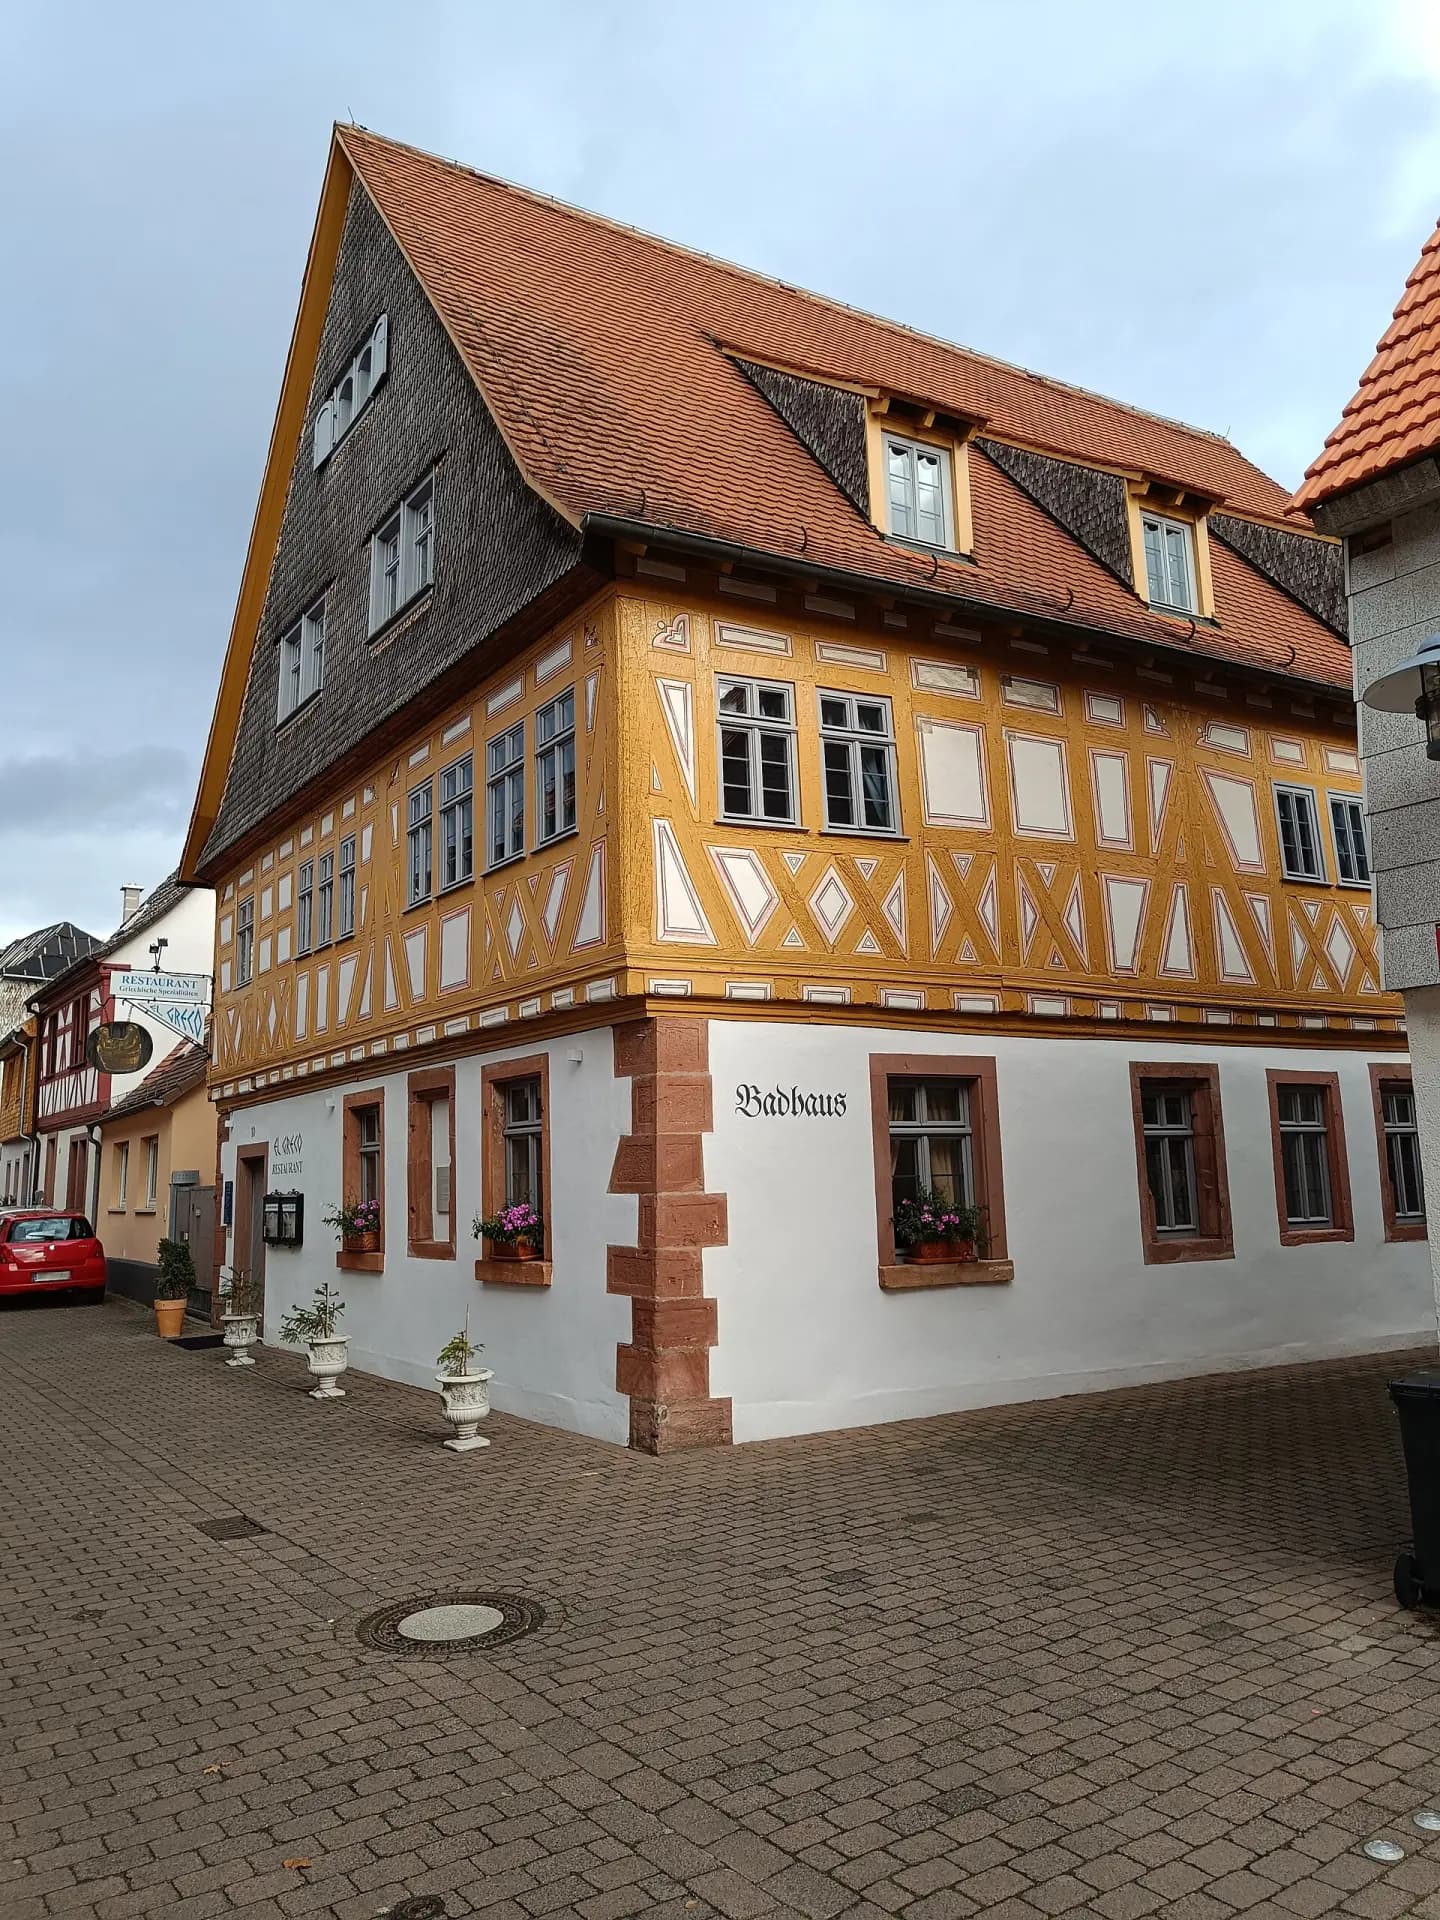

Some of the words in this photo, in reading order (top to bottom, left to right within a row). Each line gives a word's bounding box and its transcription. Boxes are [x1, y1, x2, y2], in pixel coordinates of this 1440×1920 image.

[119, 985, 157, 994] Griechische
[158, 988, 199, 997] Spezialitäten
[122, 975, 198, 989] RESTAURANT
[150, 1003, 163, 1017] EL
[167, 1006, 202, 1040] GRECO
[735, 1083, 847, 1118] Badhaus
[282, 1131, 303, 1154] GRECO
[272, 1160, 303, 1175] RESTAURANT
